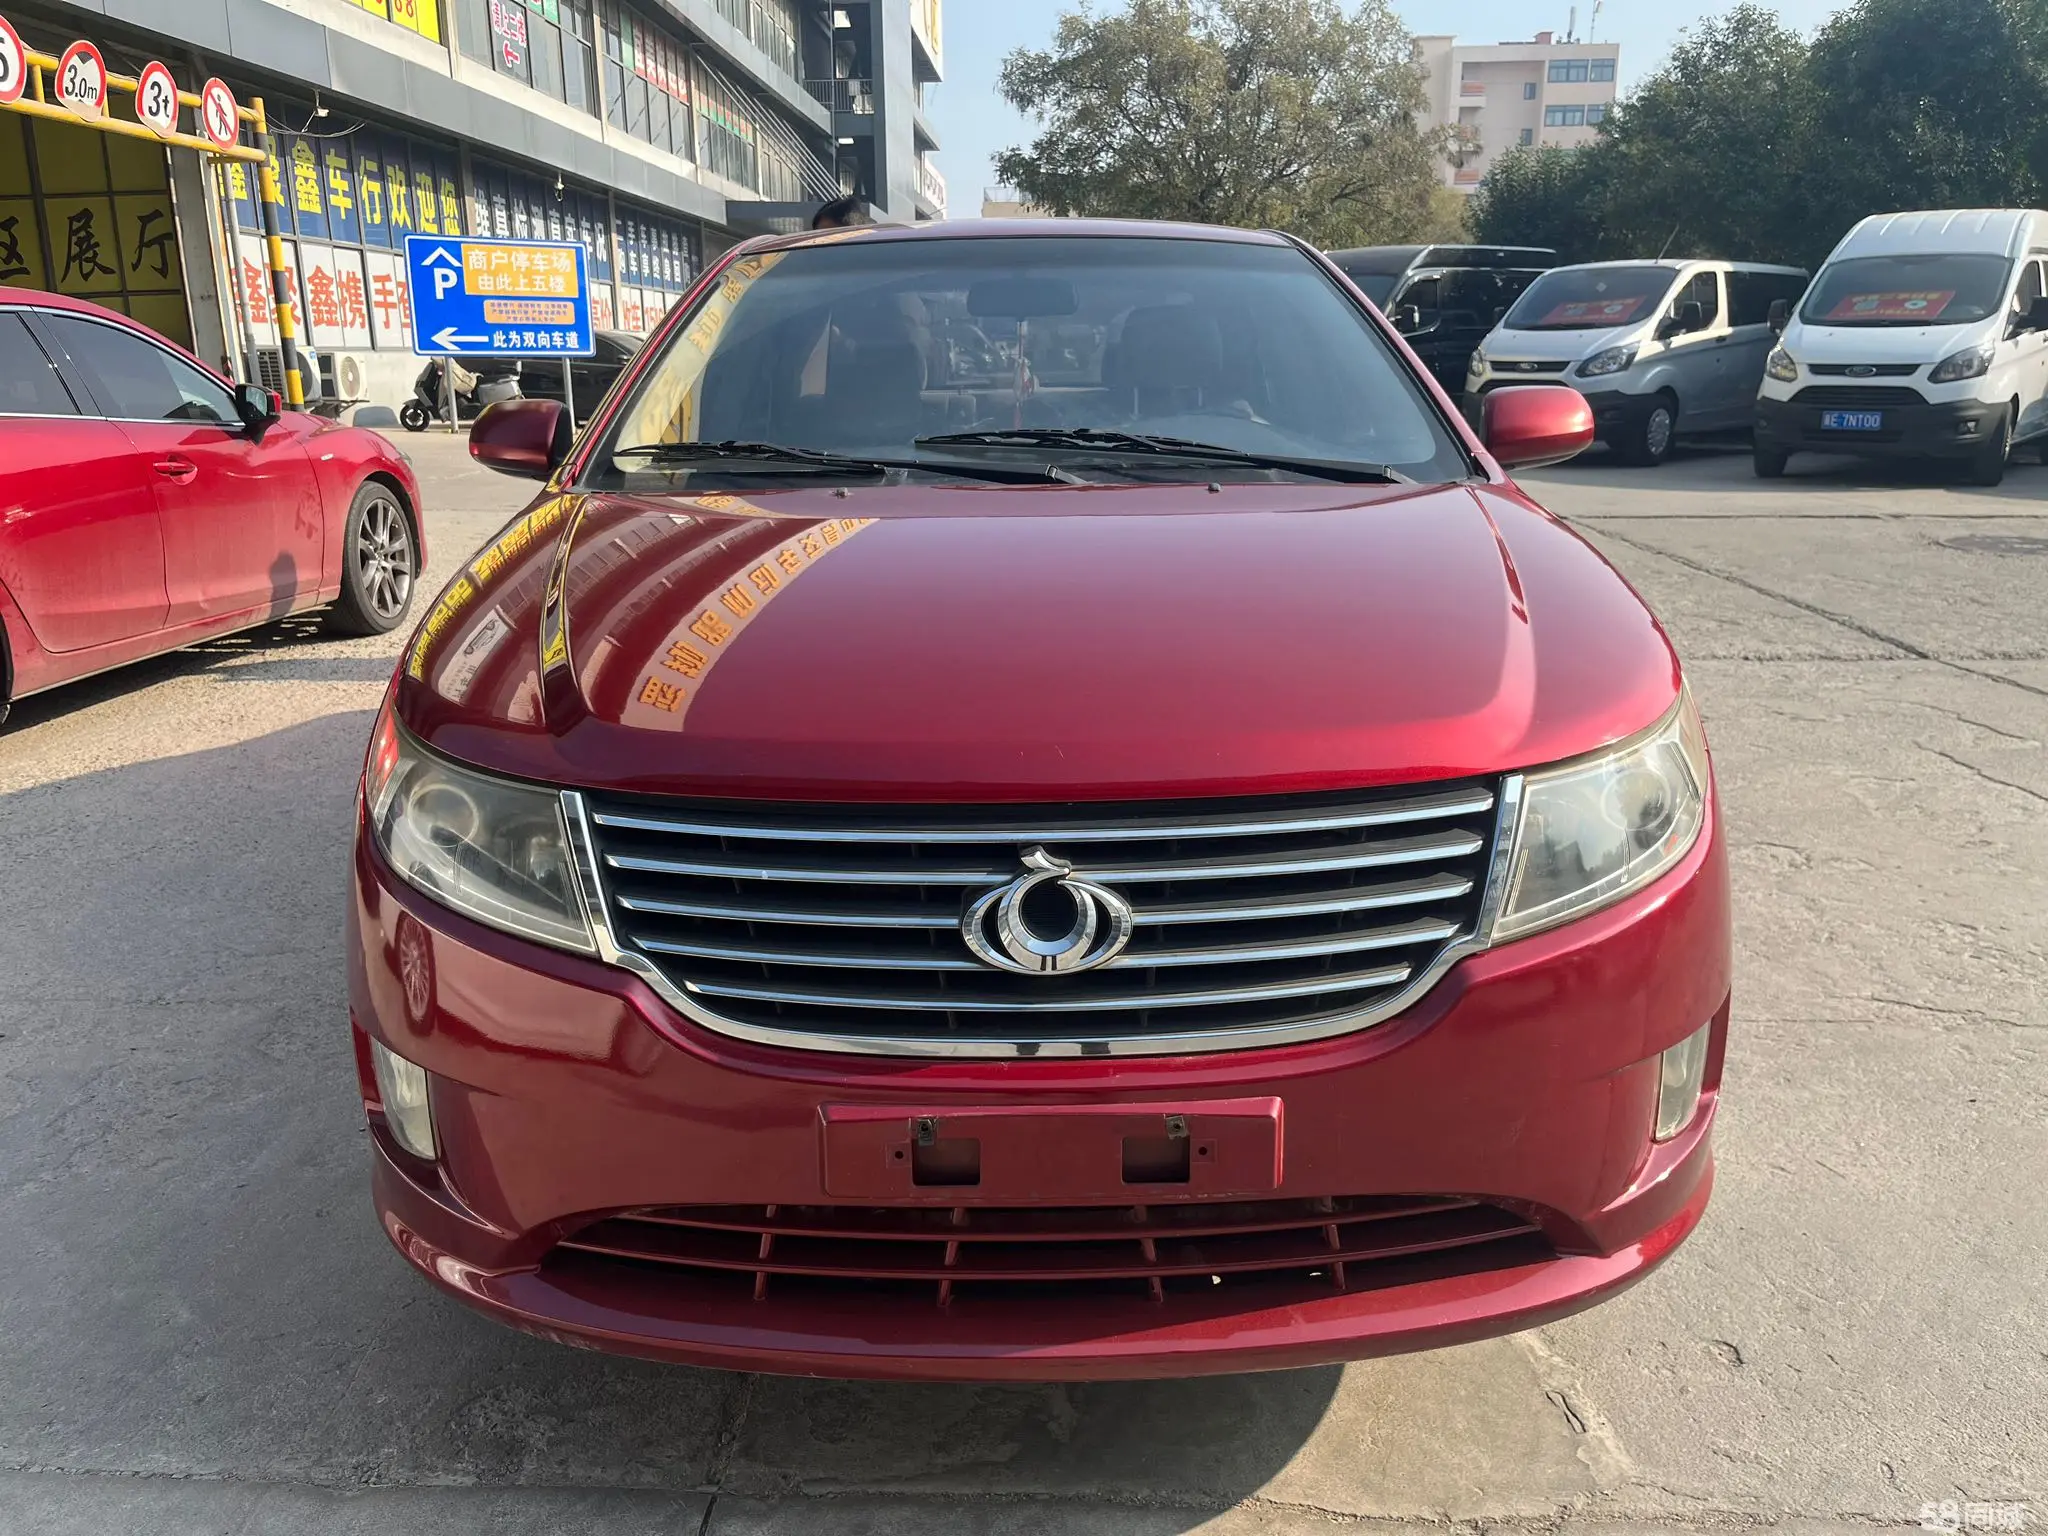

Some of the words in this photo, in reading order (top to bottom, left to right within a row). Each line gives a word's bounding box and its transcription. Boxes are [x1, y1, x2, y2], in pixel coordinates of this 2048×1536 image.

[64, 64, 98, 100] 3.0m
[148, 80, 170, 118] 3t
[468, 249, 571, 273] 商户停车场
[433, 267, 458, 300] P
[478, 273, 566, 293] 由此上五楼
[493, 330, 580, 350] 此为双向车道
